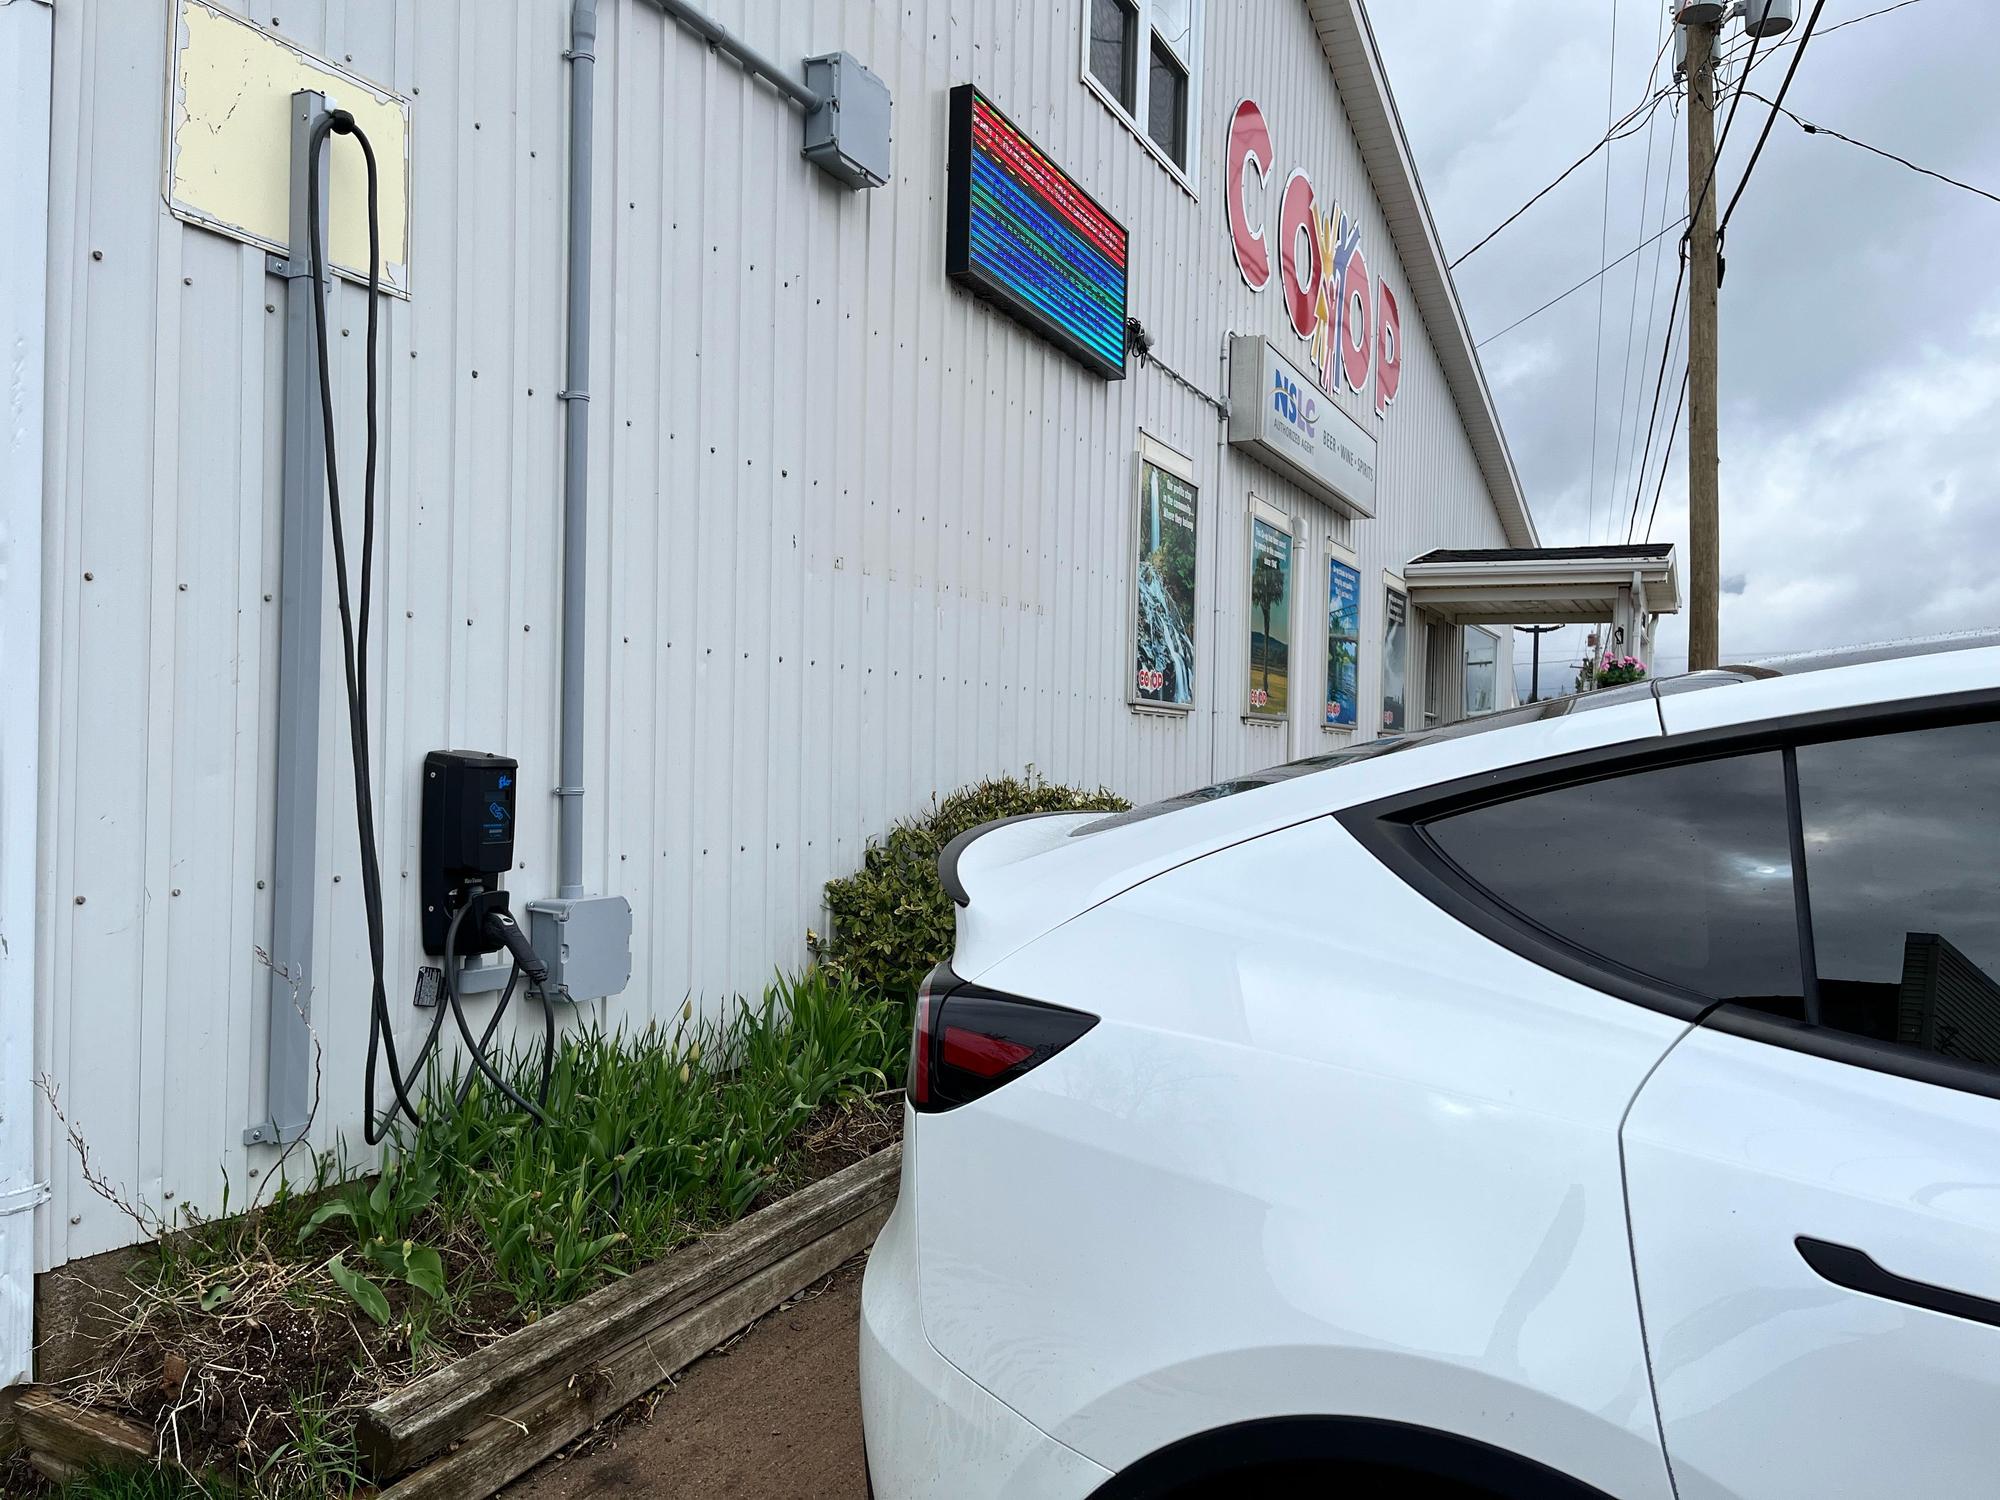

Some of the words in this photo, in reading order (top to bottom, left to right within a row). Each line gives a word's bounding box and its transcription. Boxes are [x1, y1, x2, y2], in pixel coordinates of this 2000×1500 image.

[1274, 369, 1316, 438] NSLC
[1273, 418, 1300, 446] AUTHORIZED
[1301, 437, 1315, 456] AGENT
[1322, 429, 1336, 453] BEER
[1340, 443, 1354, 467] WINE
[1357, 457, 1374, 482] SPIRITS
